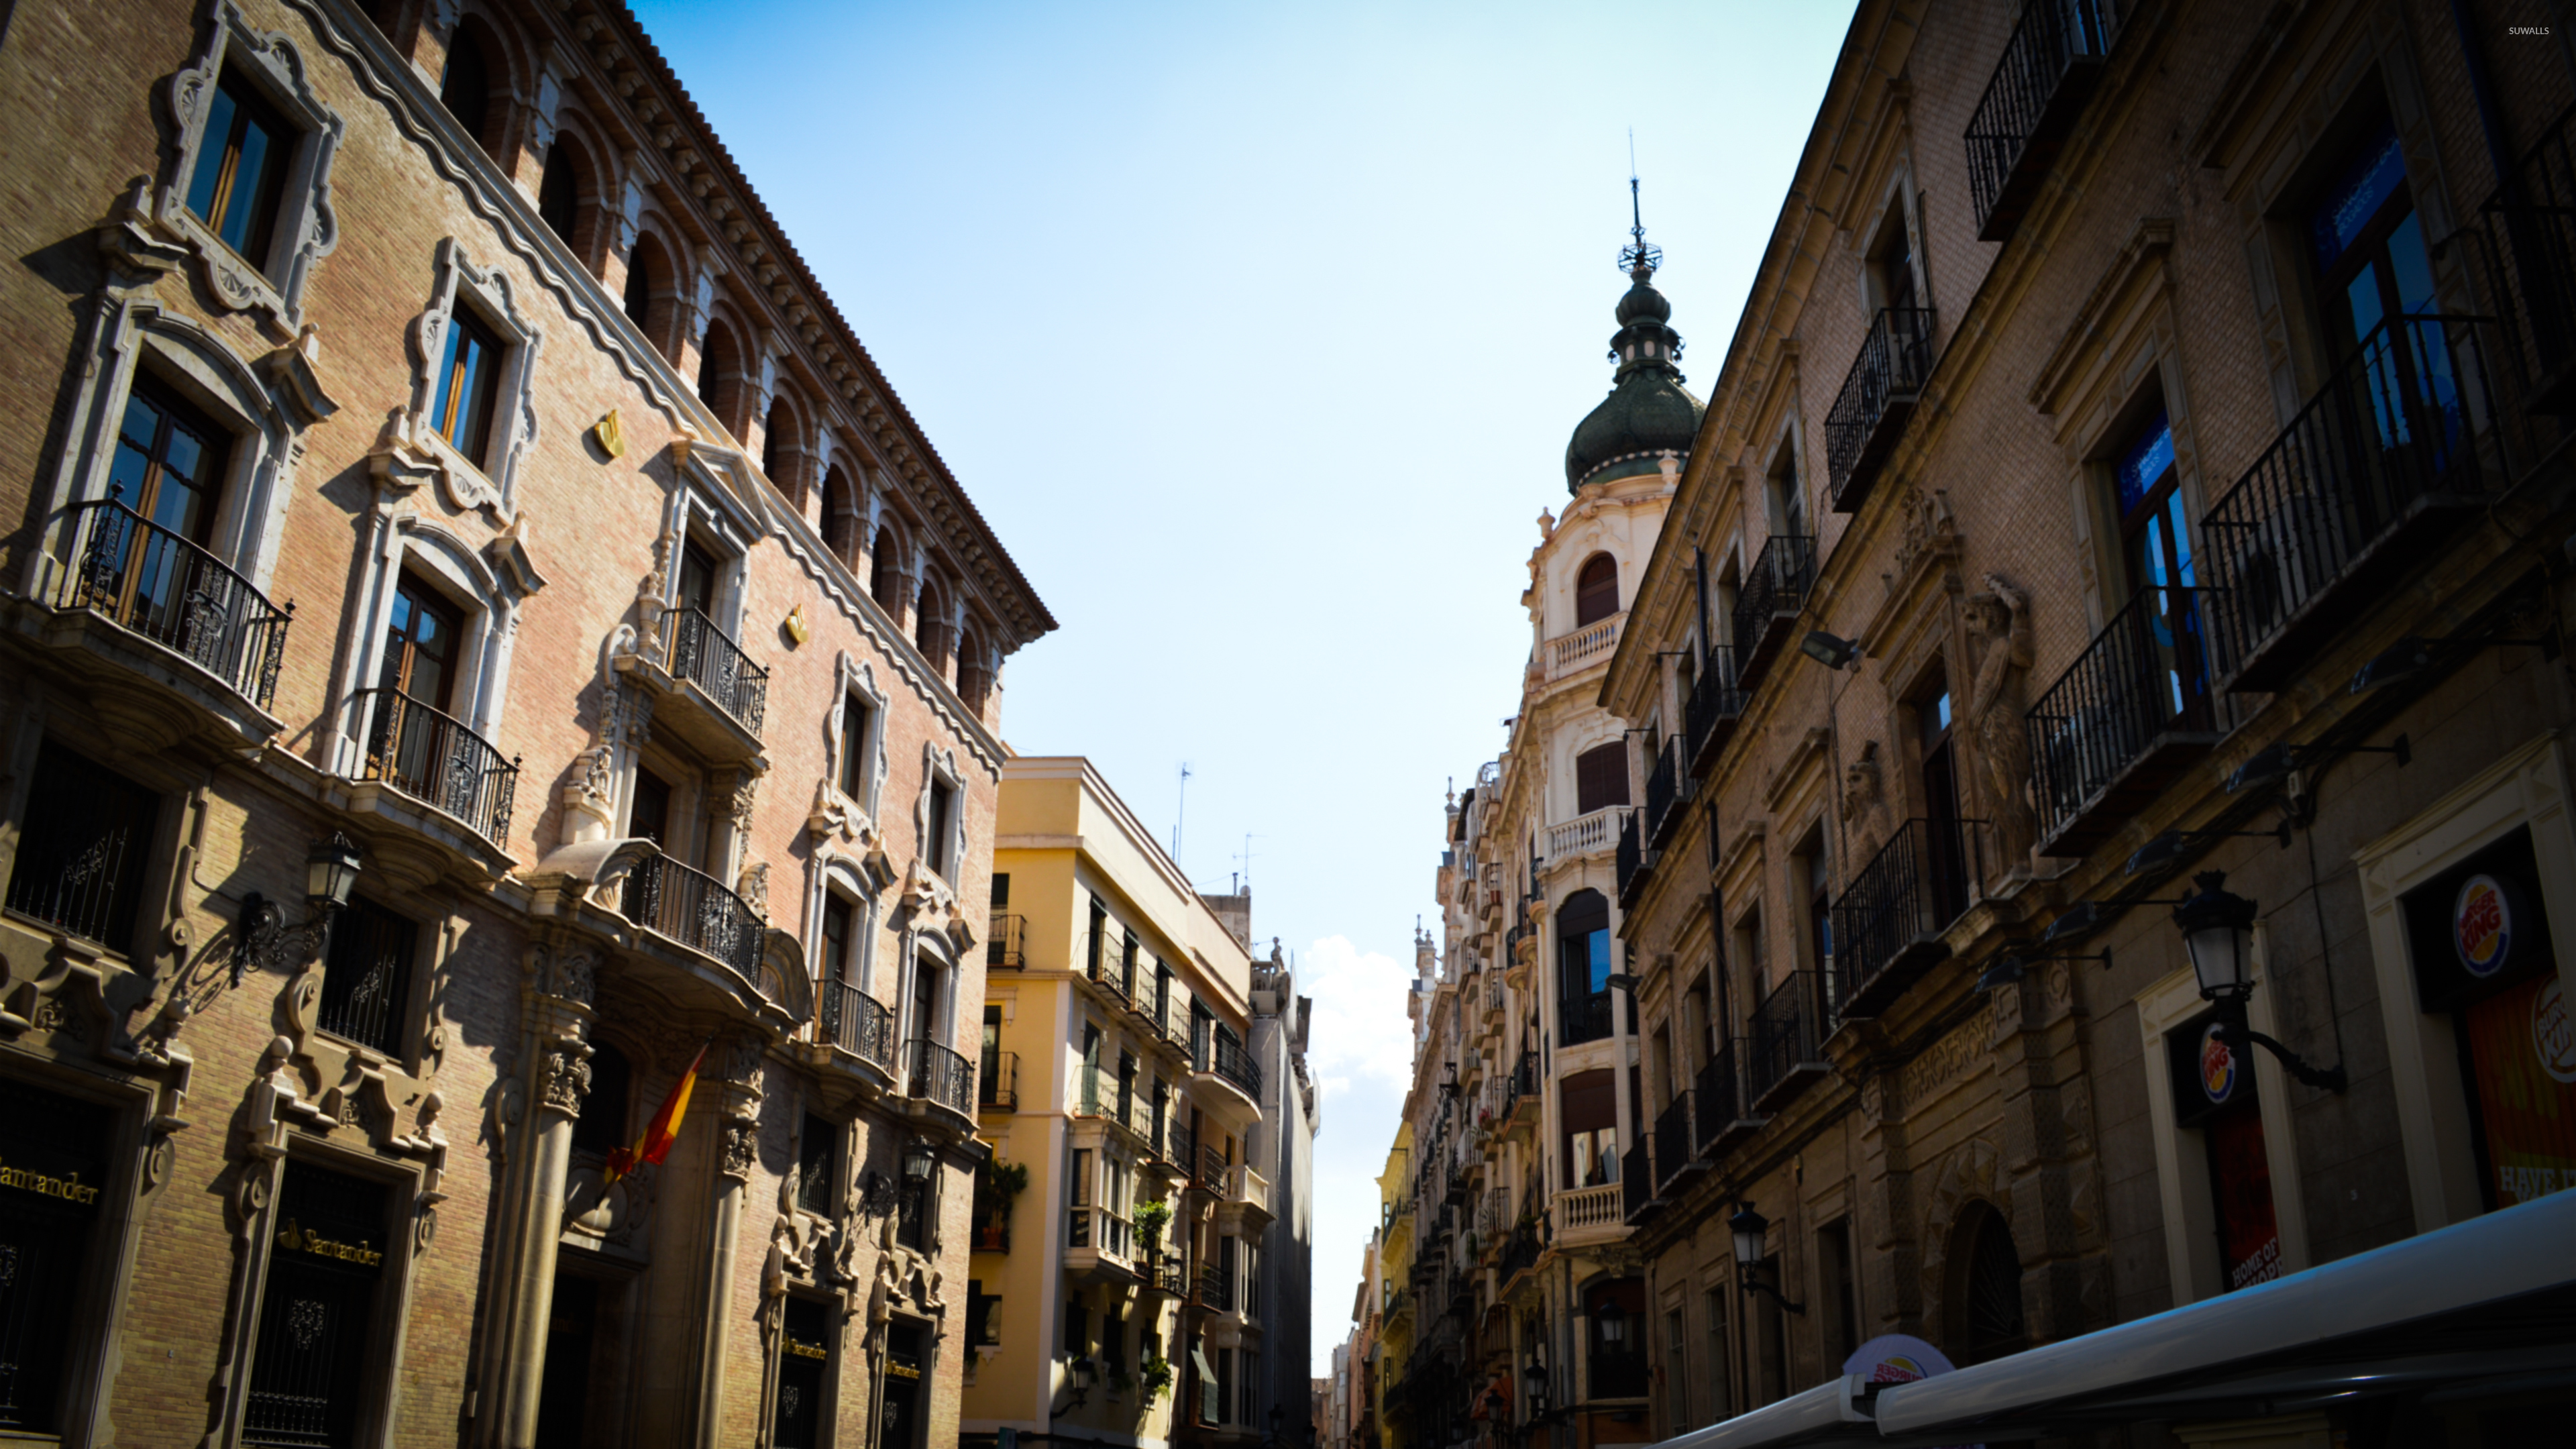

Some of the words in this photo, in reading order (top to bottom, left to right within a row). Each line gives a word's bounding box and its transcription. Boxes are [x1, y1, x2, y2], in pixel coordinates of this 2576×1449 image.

[2459, 890, 2496, 928] BURGER
[2463, 906, 2501, 959] KING
[0, 1156, 99, 1205] antander
[2499, 1166, 2557, 1195] HAVE
[304, 1228, 382, 1267] Santander
[2232, 1249, 2263, 1288] HOME
[2263, 1236, 2277, 1262] OF
